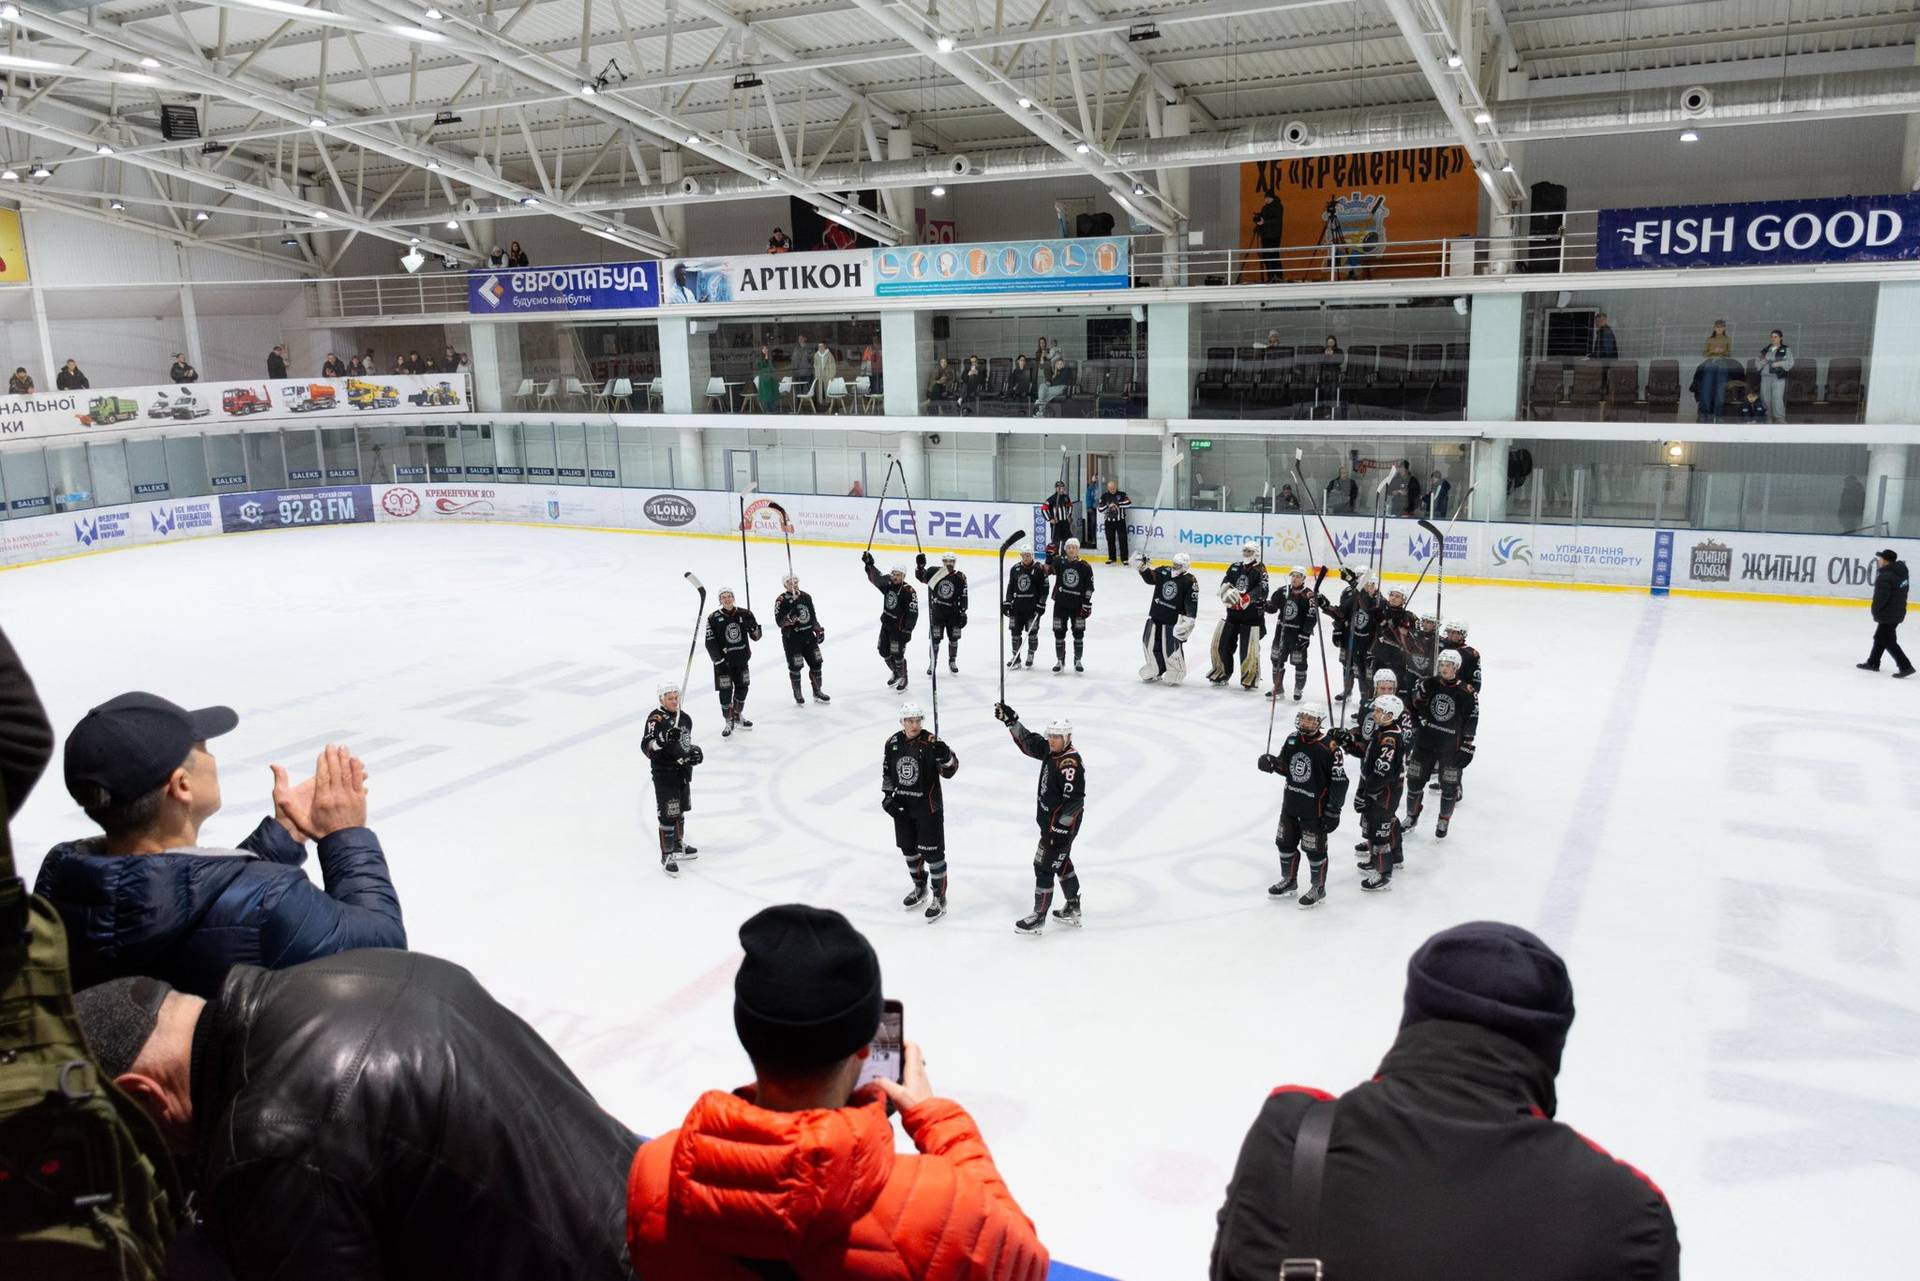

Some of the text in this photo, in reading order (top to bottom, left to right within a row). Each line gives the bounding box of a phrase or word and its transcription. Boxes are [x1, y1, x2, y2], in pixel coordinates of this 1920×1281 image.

[1632, 210, 1903, 256] FISH GOOD
[512, 266, 648, 293] ЄВРОПАБУД
[740, 263, 862, 291] АРТІКОН
[512, 295, 549, 307] будуємо
[592, 470, 613, 478] SALEKS
[215, 477, 243, 485] SALEKS
[137, 484, 166, 492] SALEKS
[279, 497, 355, 523] 92.8 FM
[653, 504, 688, 516] ILONA
[878, 509, 1001, 539] ICE PEAK
[1358, 531, 1389, 539] ФЕДЕАЦЯ
[1358, 547, 1382, 555] УКРАНИ
[1432, 543, 1468, 552] FEERATION
[1555, 545, 1624, 555] УПРАВЛІННЯ
[1540, 553, 1642, 567] МОЛОДІ ТА СПОРТУ
[1694, 550, 1728, 564] ЖИТНЯ
[1693, 564, 1727, 577] СЛЬОЗА
[1741, 552, 1878, 586] ЖИТНЯ СЛЬО
